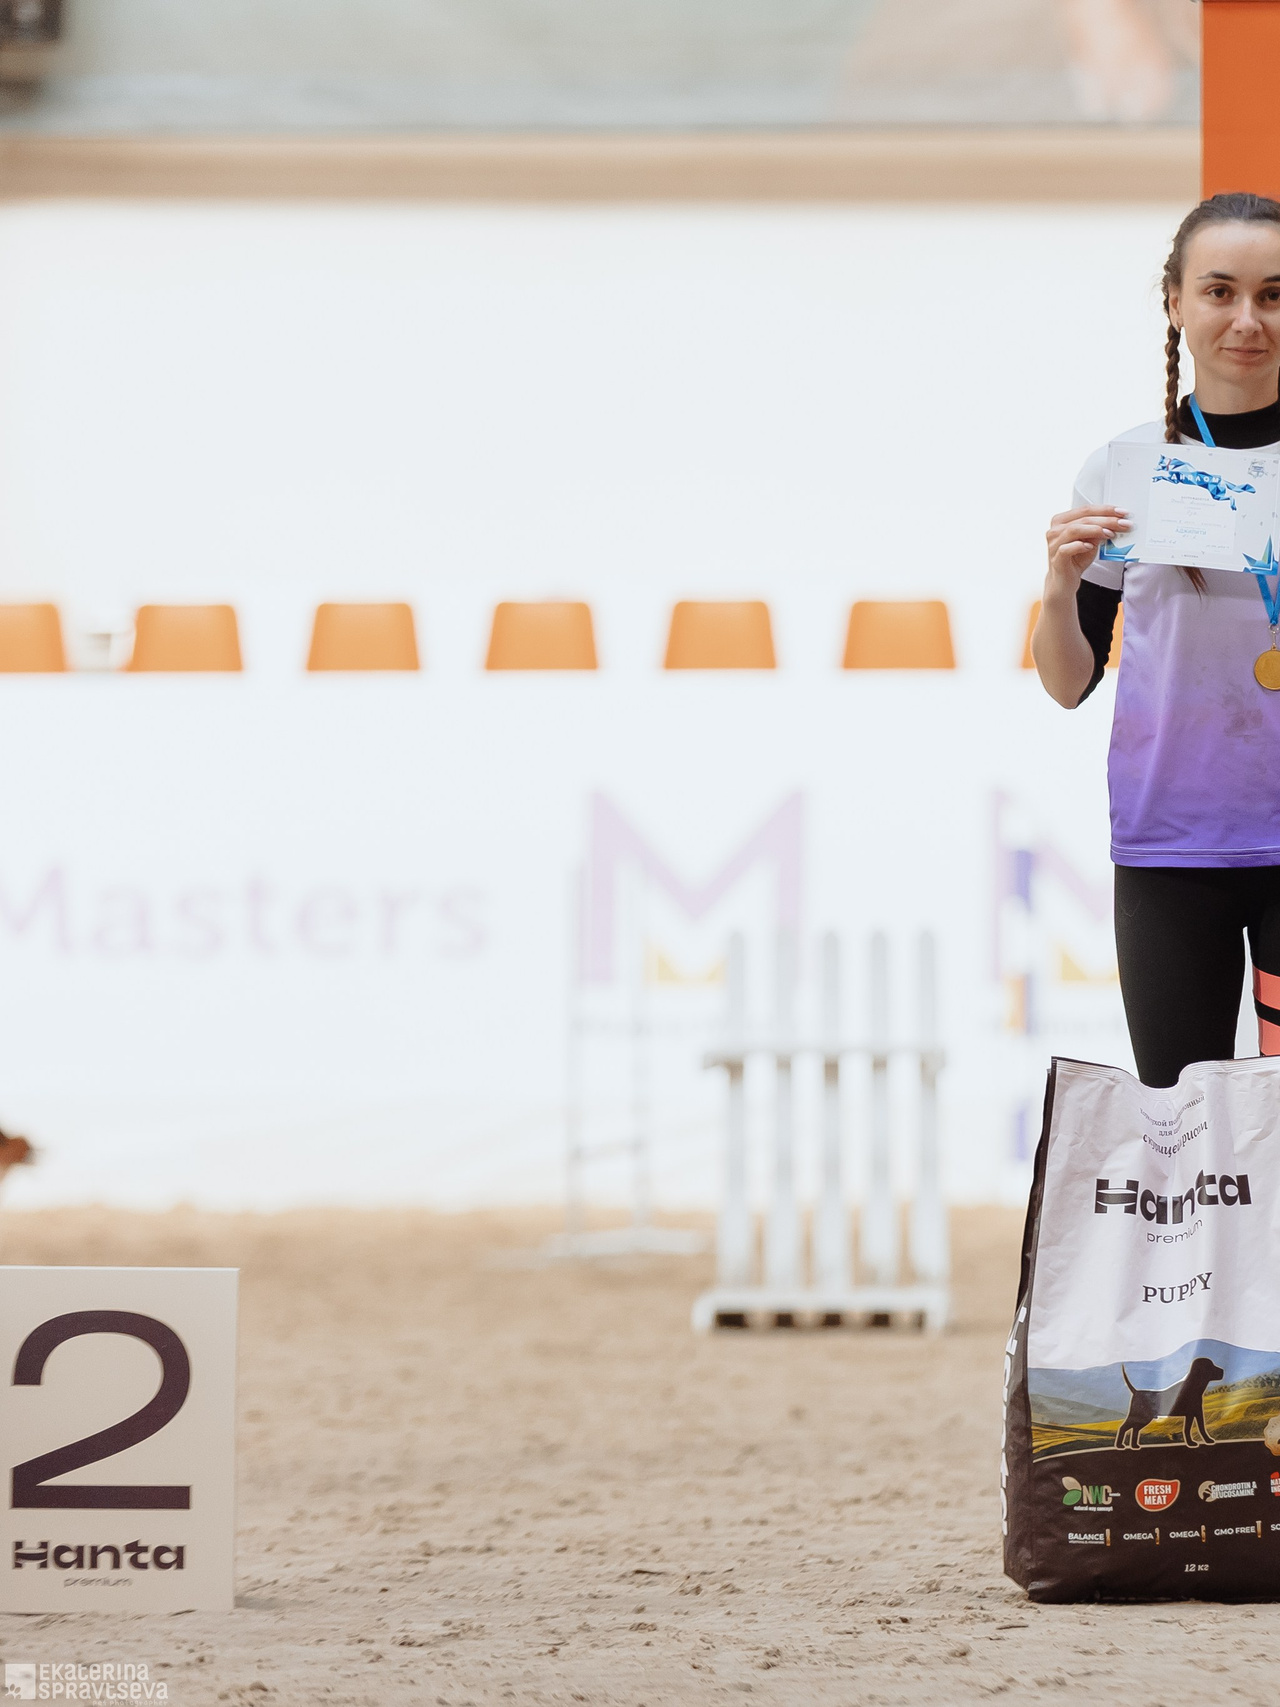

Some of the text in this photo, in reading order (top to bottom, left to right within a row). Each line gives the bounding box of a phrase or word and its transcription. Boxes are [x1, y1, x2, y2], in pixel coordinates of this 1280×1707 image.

[1171, 473, 1220, 483] ДИПЛОМ
[1094, 1168, 1252, 1225] Hanta
[1147, 1218, 1203, 1244] premium
[1142, 1271, 1213, 1304] PUPPY
[10, 1308, 192, 1511] 2
[1143, 1484, 1172, 1495] FRESH
[1082, 1485, 1113, 1506] NWC
[1144, 1495, 1168, 1506] MEAT
[1169, 1530, 1200, 1539] OMEGA
[1214, 1525, 1256, 1536] GMO FREE
[1123, 1532, 1154, 1541] OMEGA
[12, 1538, 187, 1570] Hanta
[1184, 1563, 1196, 1573] 12
